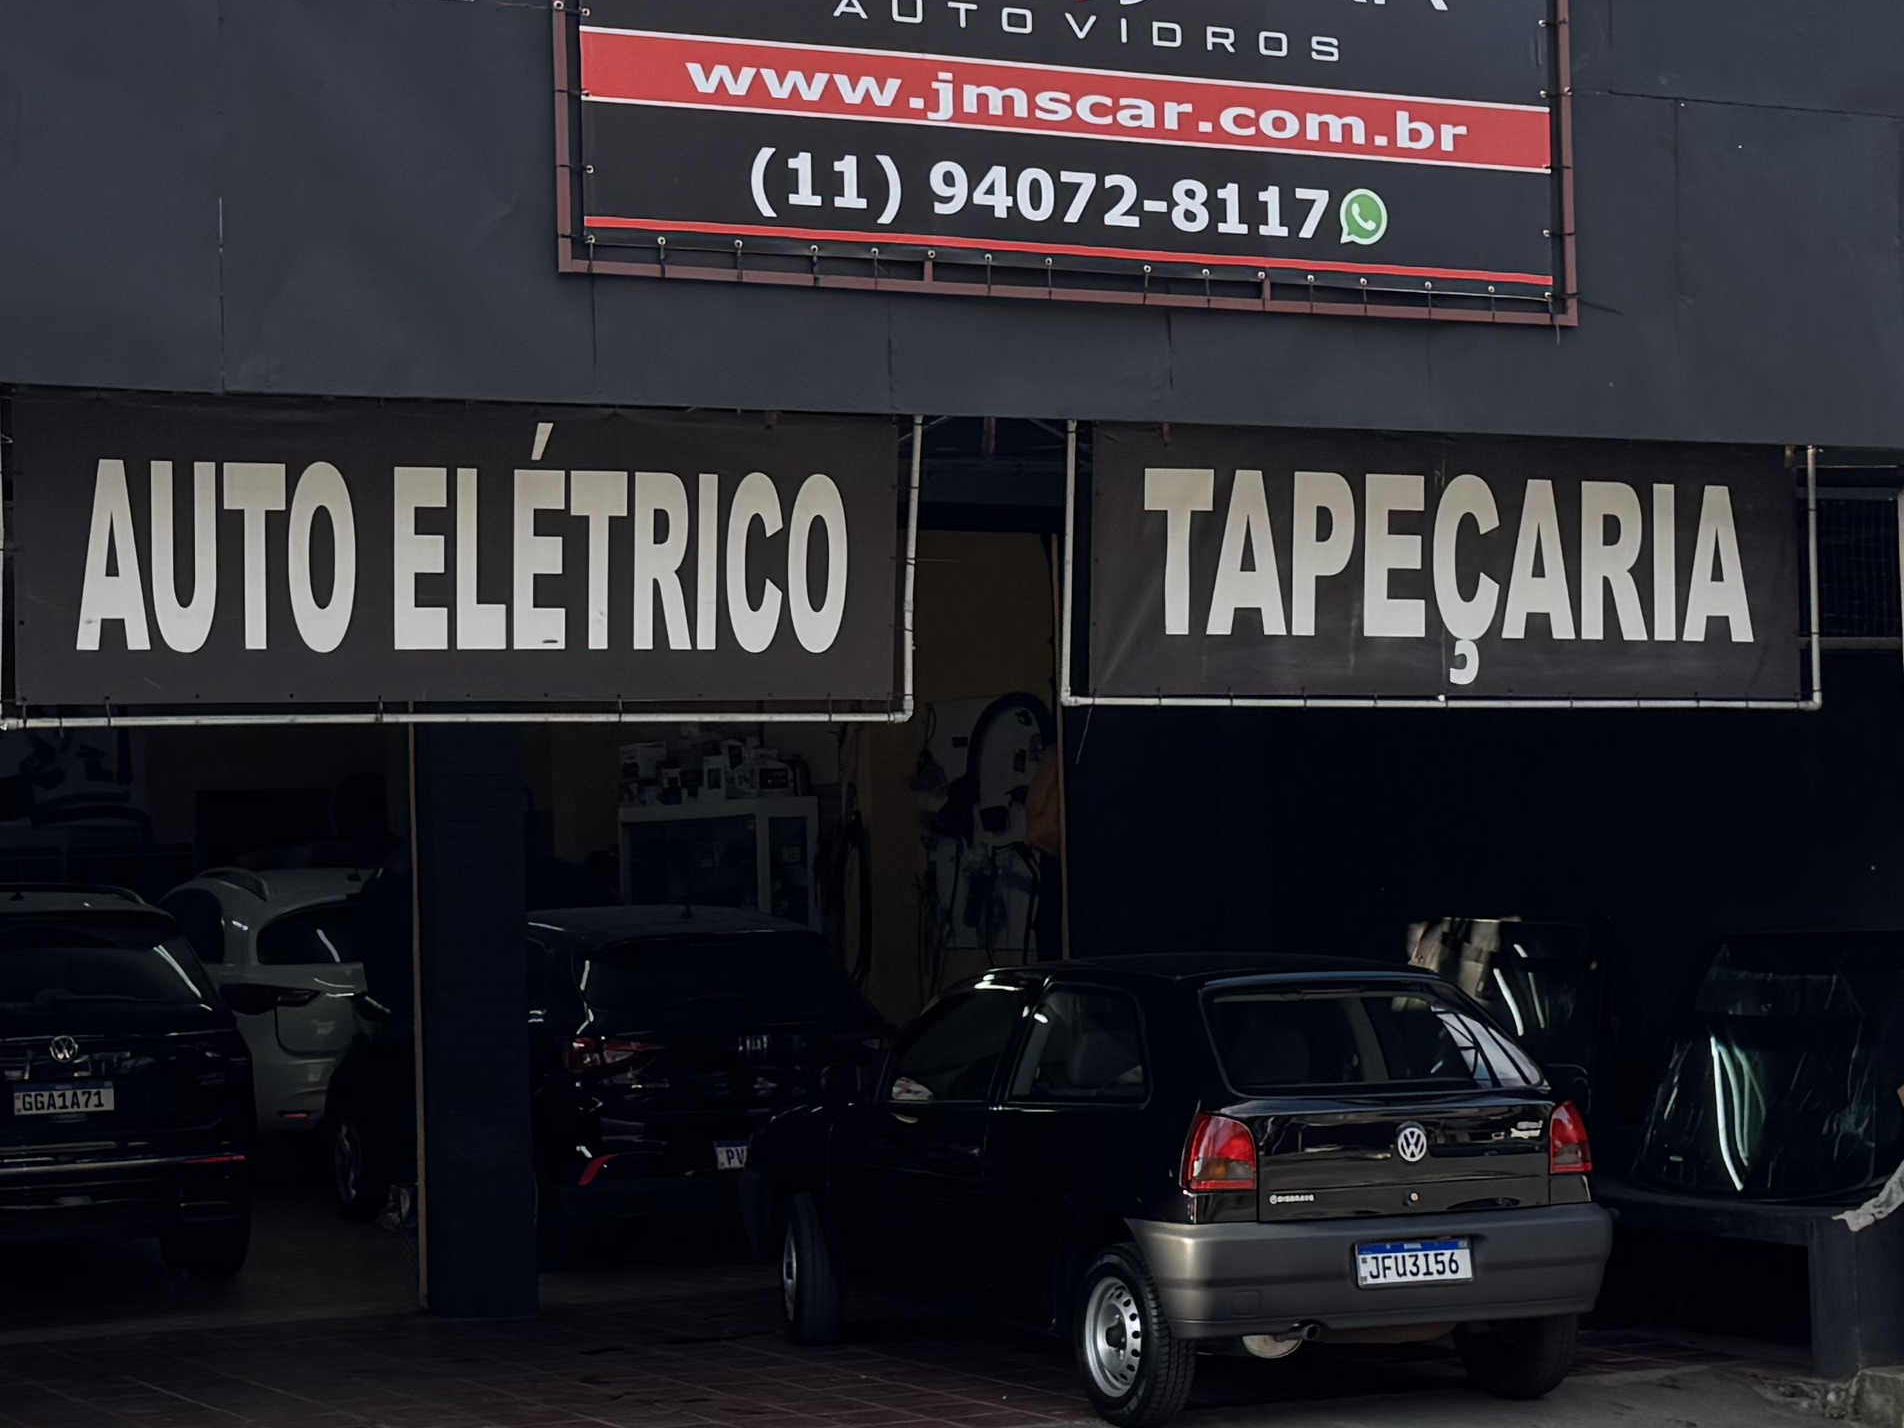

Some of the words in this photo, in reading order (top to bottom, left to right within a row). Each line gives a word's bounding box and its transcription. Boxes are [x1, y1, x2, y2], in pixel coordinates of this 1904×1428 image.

[686, 60, 1468, 151] www.jmscar.com.br
[751, 147, 901, 224] (11)
[926, 161, 1329, 241] 94072-8117
[76, 459, 355, 653] AUTO
[394, 423, 847, 653] ELÉTRICO
[1145, 468, 1754, 684] TAPEÇARIA
[23, 1092, 106, 1111] GGA1A71
